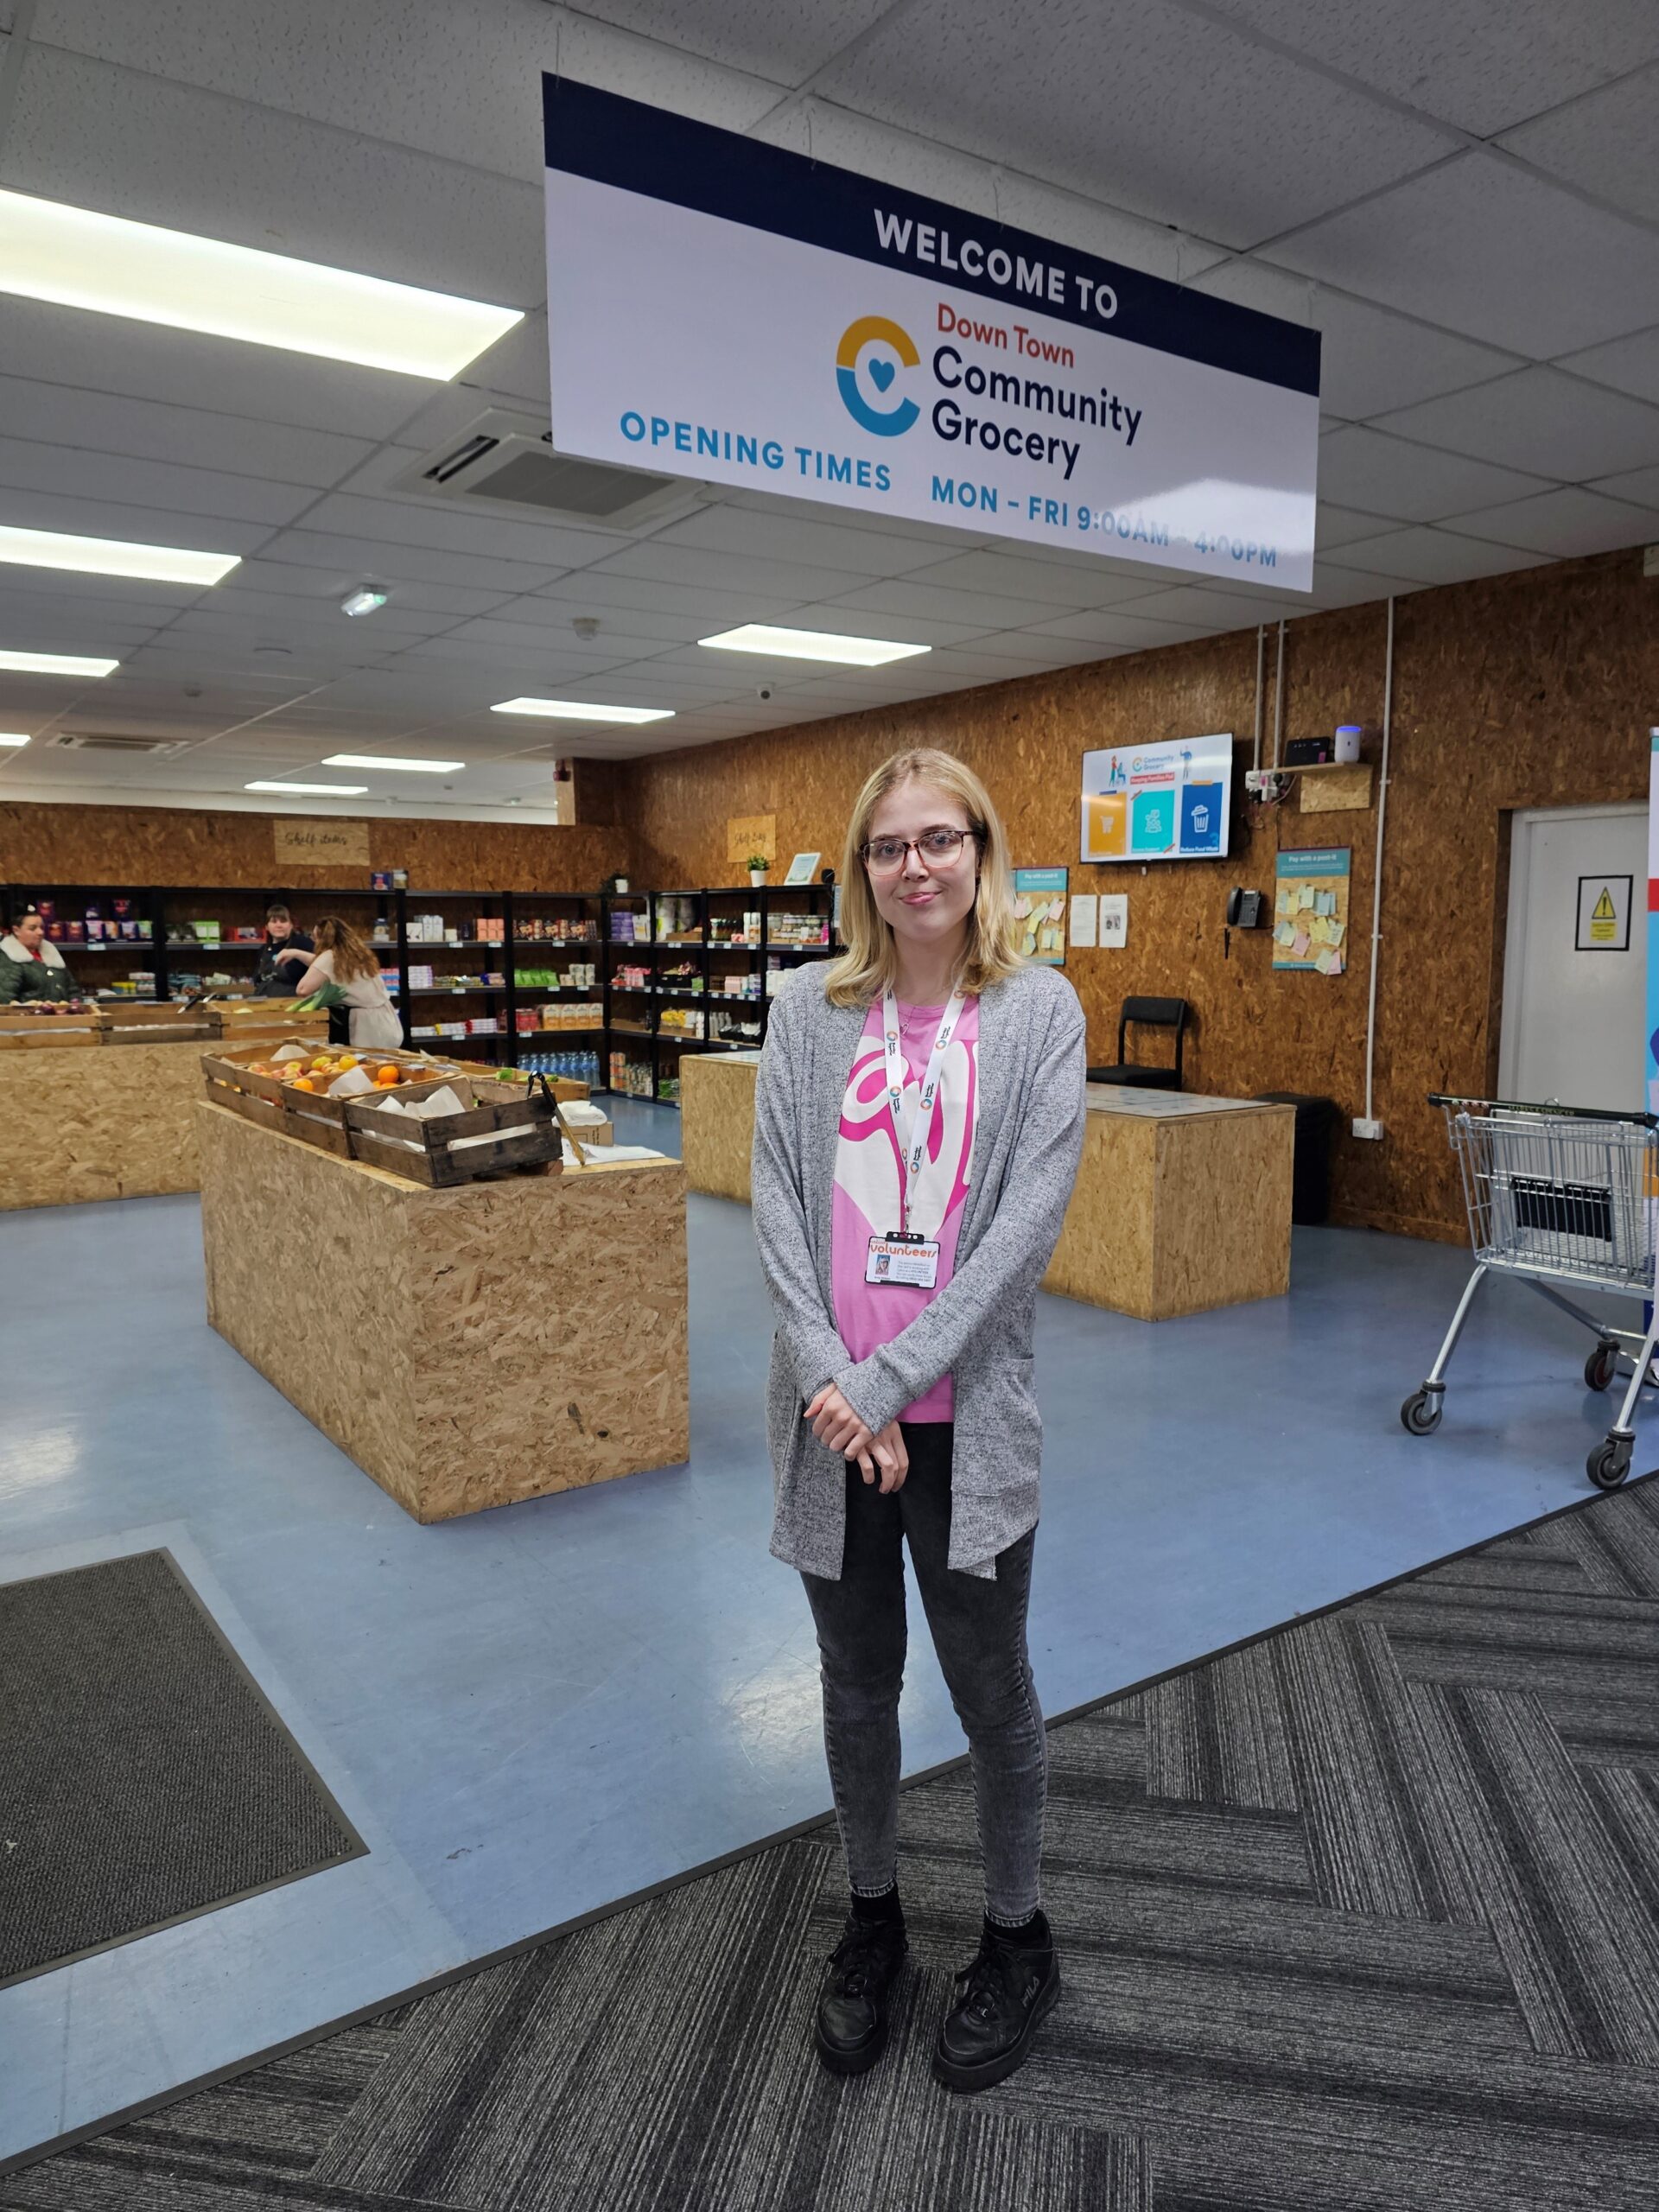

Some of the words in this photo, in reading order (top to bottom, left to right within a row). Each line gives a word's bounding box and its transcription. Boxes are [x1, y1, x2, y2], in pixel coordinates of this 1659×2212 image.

[874, 208, 1065, 304] WELCOME
[1075, 276, 1118, 319] TO
[938, 302, 1007, 350] Down
[1013, 325, 1075, 368] Town
[931, 398, 1080, 480] Grocery
[932, 346, 1142, 446] Community
[620, 411, 785, 469] OPENING
[794, 447, 891, 491] TIMES
[931, 475, 998, 513] MON
[1028, 495, 1068, 527] FRI
[1077, 505, 1169, 547] 9:00AM
